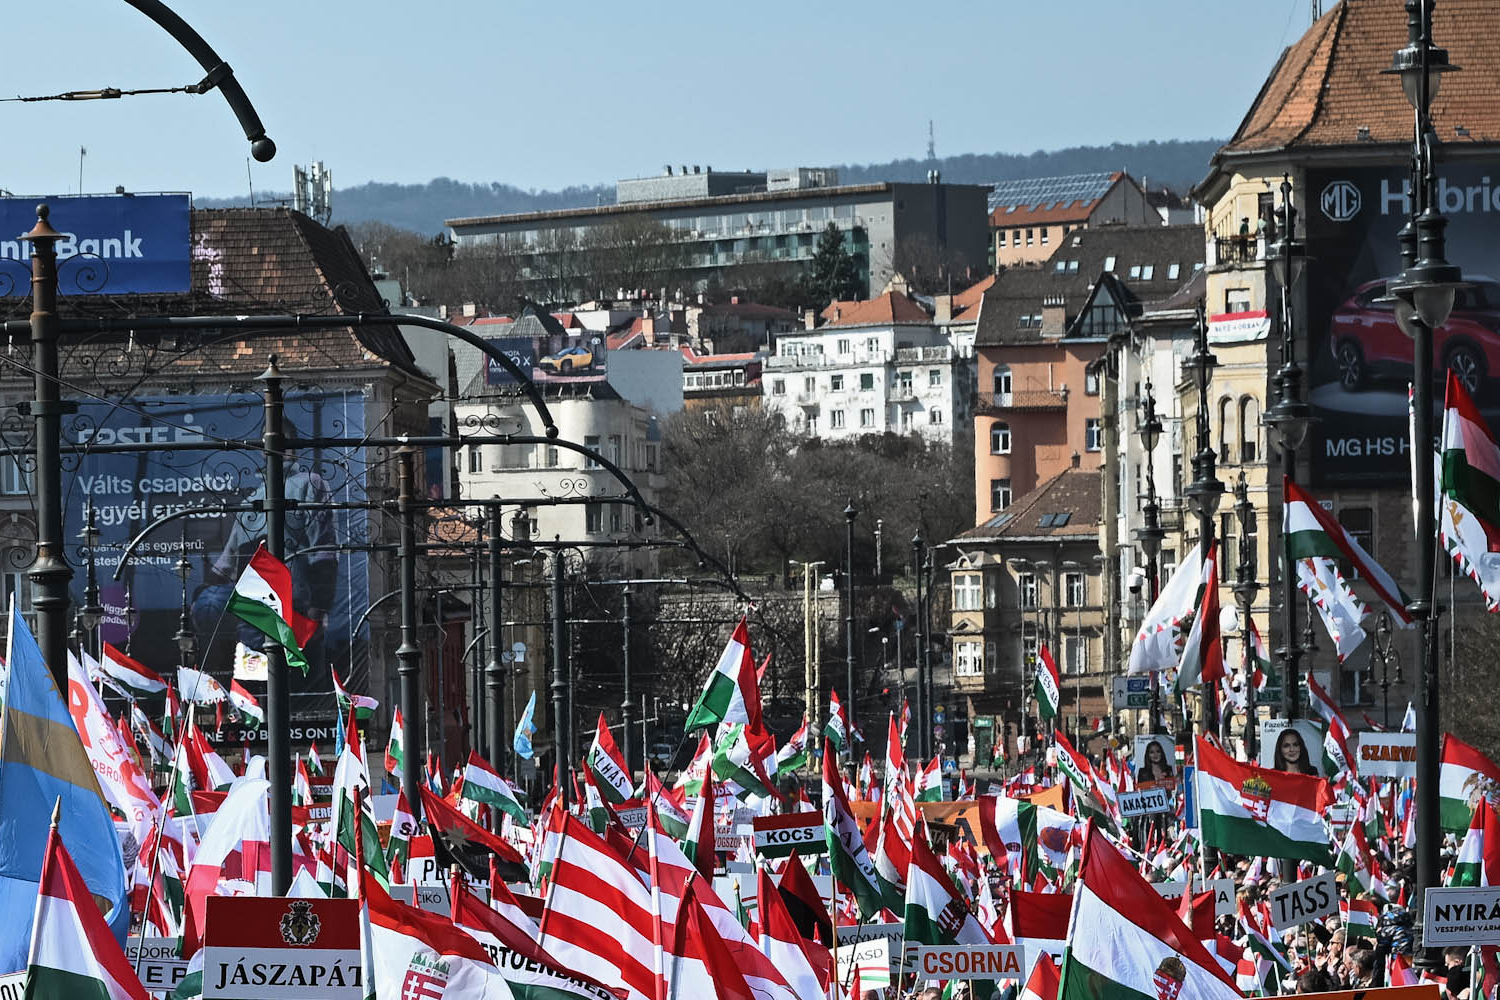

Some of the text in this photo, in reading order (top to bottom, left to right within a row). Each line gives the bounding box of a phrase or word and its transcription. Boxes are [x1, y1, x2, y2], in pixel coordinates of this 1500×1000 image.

[56, 230, 143, 259] Bank
[1326, 438, 1362, 457] MG
[1366, 437, 1395, 455] HS
[78, 474, 132, 495] Válts
[239, 730, 256, 742] 20
[306, 727, 328, 740] ON
[1123, 792, 1164, 812] AKASZTÓ
[766, 827, 814, 844] KOCS
[1275, 880, 1329, 924] TASS
[1434, 896, 1500, 922] NYIRÁ
[1434, 924, 1475, 934] VESZPRÉM
[923, 951, 1021, 974] CSORNA
[215, 957, 363, 990] JÁSZAPÁT
